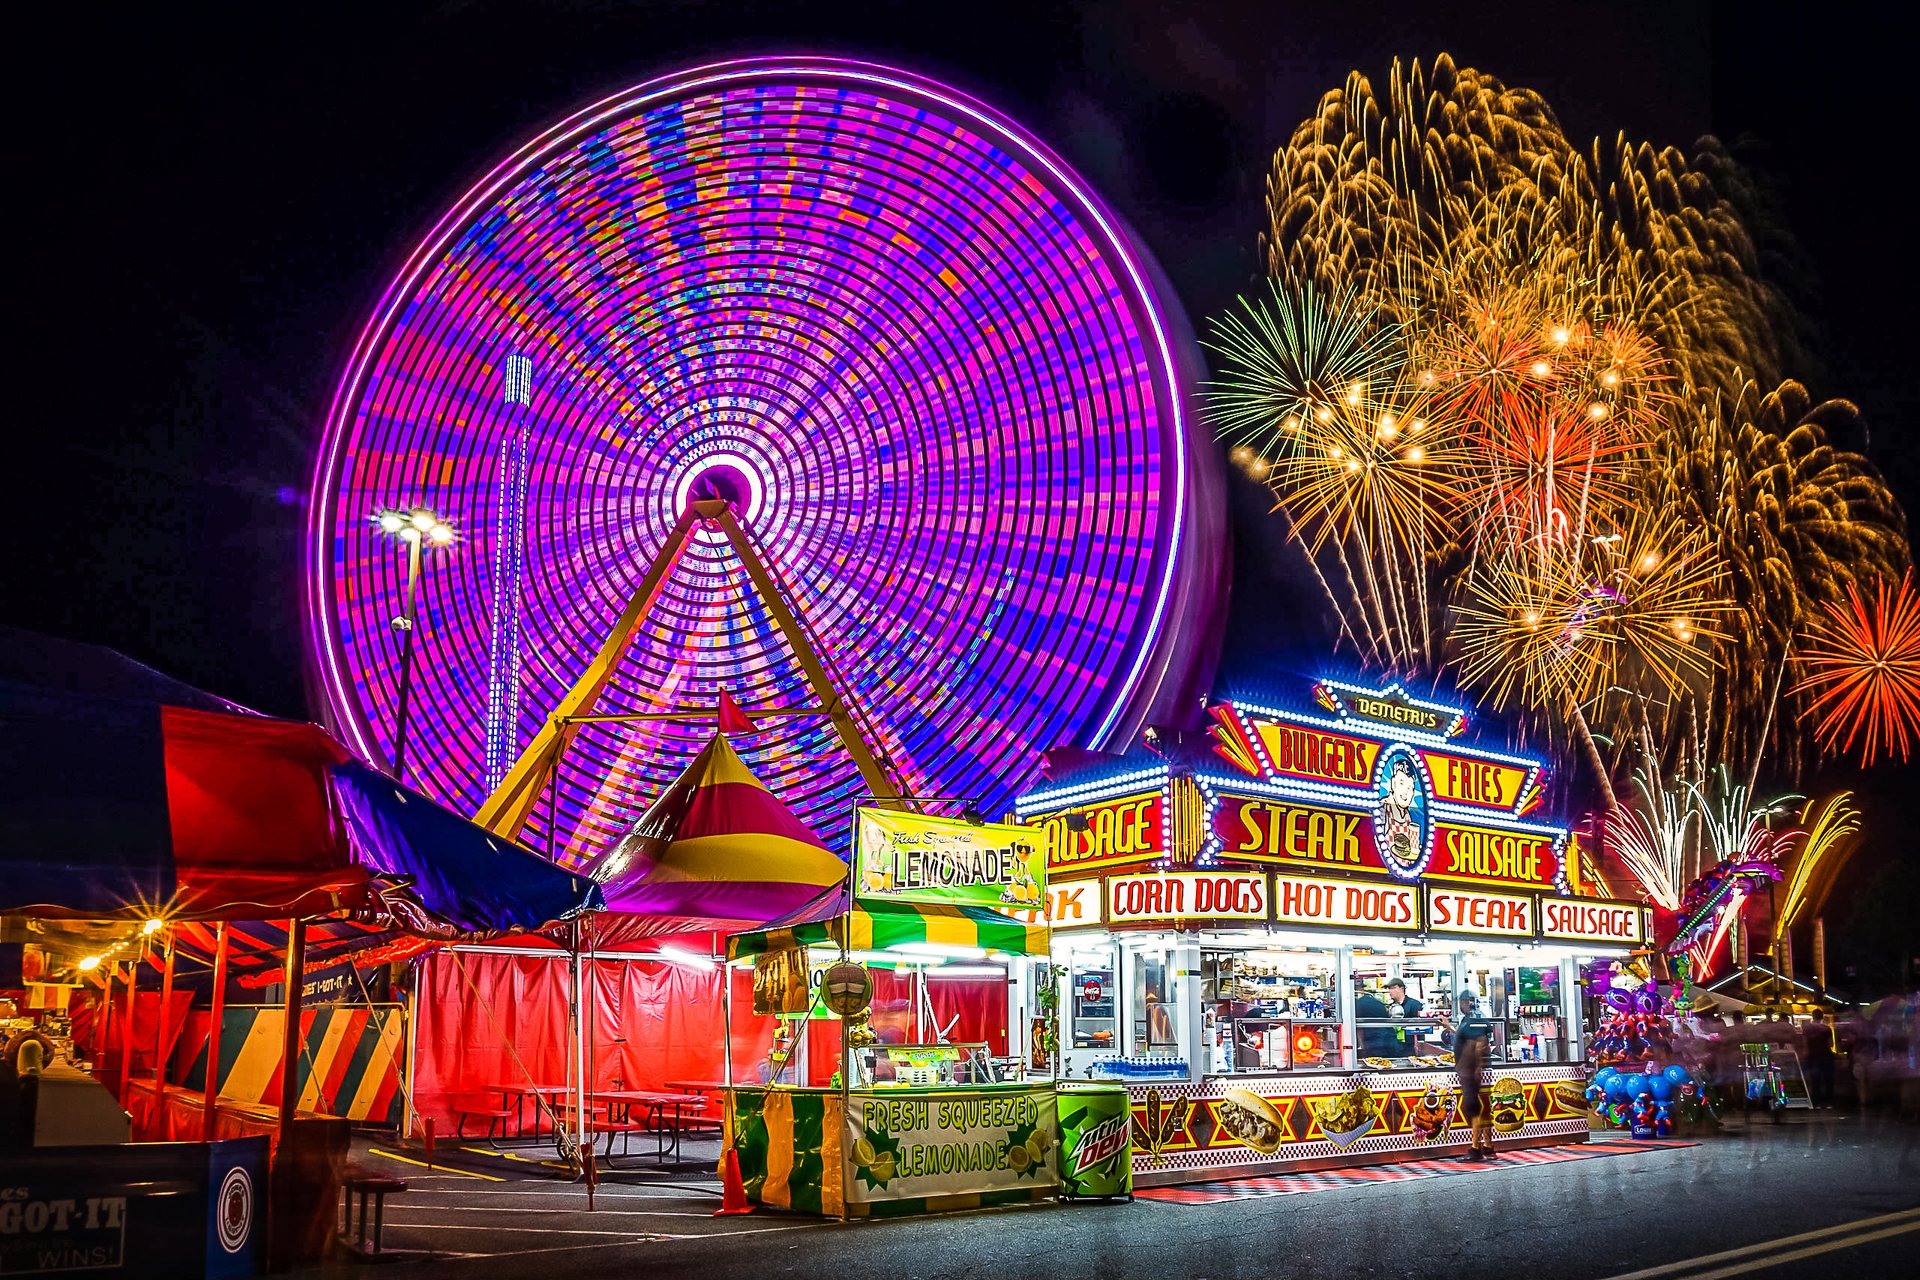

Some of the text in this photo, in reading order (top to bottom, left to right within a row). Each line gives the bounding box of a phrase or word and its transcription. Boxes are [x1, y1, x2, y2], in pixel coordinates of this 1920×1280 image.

[1356, 698, 1436, 728] DEMETRI'S
[1280, 729, 1367, 781] BURGERS
[1448, 759, 1502, 803] FRIES
[892, 831, 920, 845] Fresh
[1028, 799, 1153, 864] AUSAGE
[1239, 801, 1361, 863] STEAK
[893, 848, 1013, 890] LEMONADE
[1446, 829, 1543, 881] SAUSAGE
[1113, 878, 1184, 915] CORN
[1194, 878, 1264, 914] DOGS
[1283, 881, 1412, 923] HOT DOGS
[1433, 895, 1528, 931] STEAK
[1547, 903, 1634, 938] SAUSAGE
[862, 1096, 1039, 1134] FRESH SQUEEZED
[900, 1140, 1008, 1178] LEMONADE
[36, 1246, 113, 1270] WINS!
